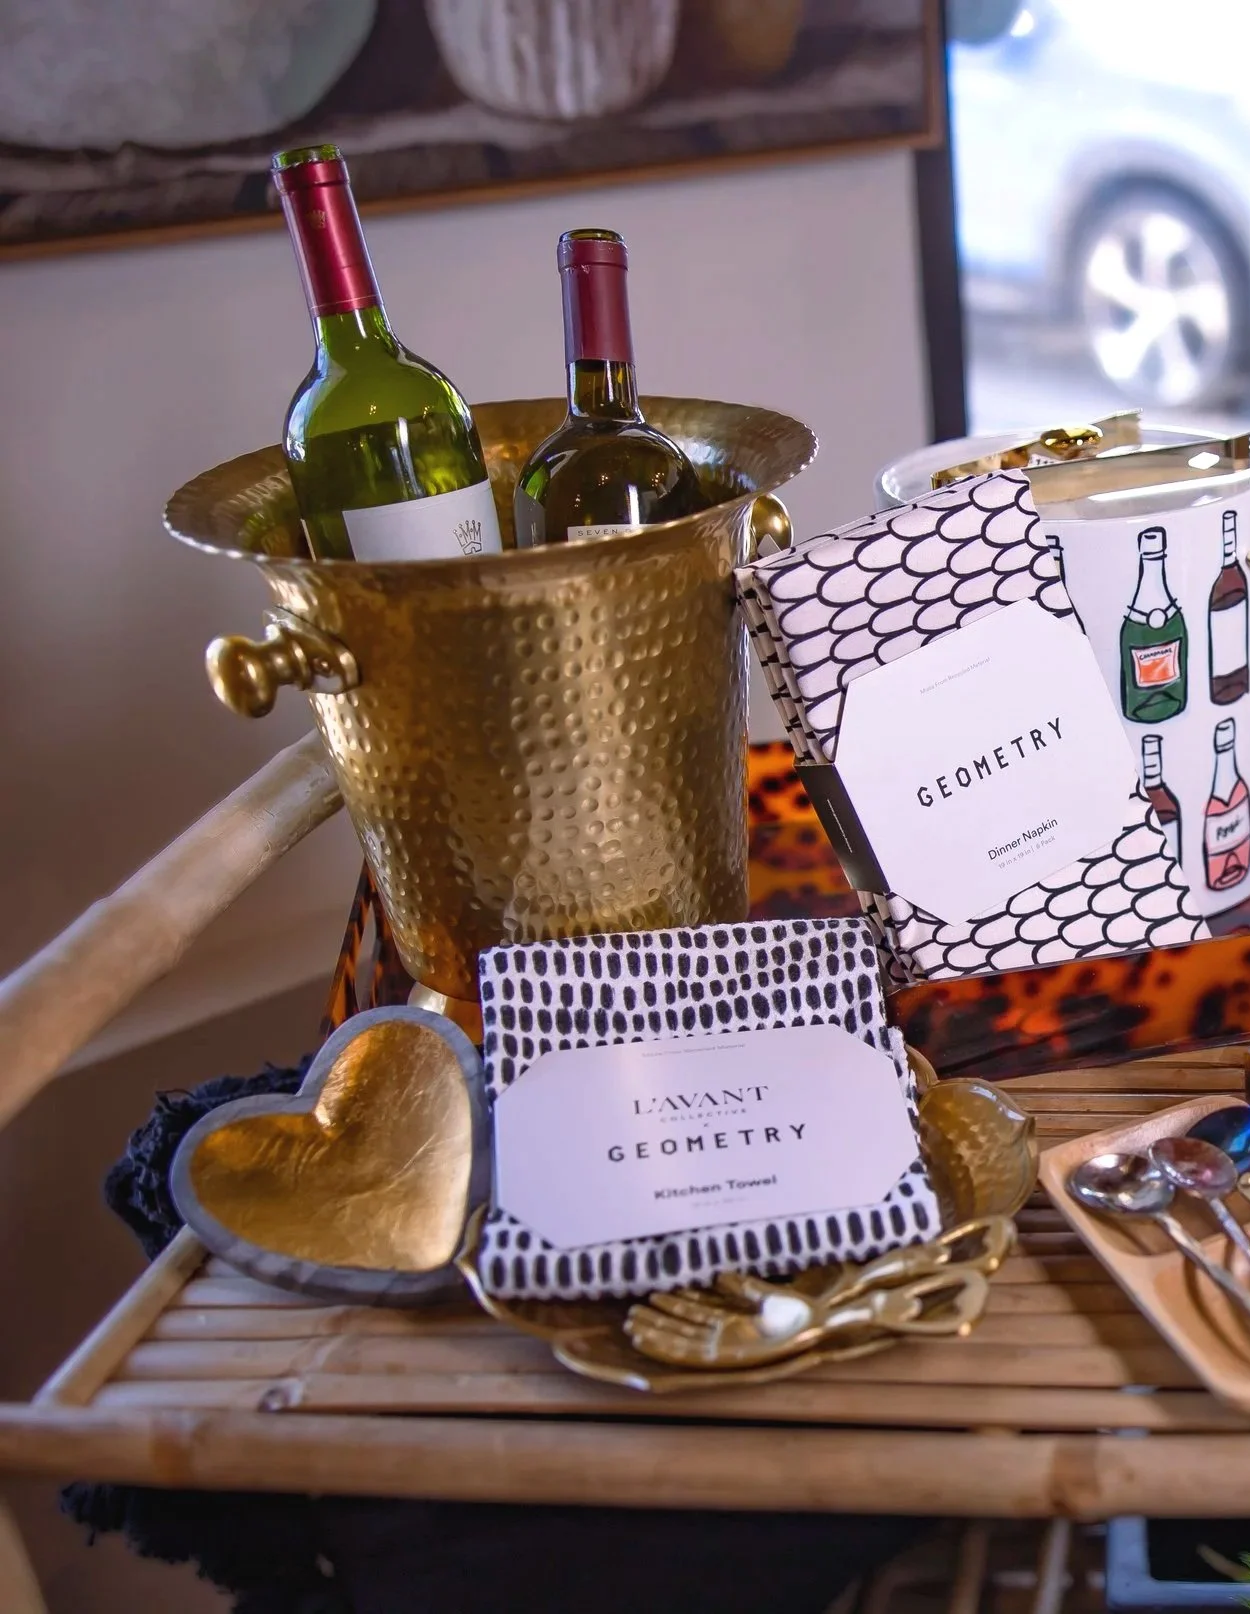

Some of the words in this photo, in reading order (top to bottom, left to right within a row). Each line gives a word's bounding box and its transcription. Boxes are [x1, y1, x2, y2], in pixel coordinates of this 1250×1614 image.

[577, 528, 618, 537] SEVEN
[917, 717, 1062, 807] GEOMETRY
[987, 837, 1021, 860] Dinner
[1022, 819, 1058, 842] Napkin
[633, 1085, 769, 1115] L'AVANT
[659, 1108, 747, 1124] COLLECTIVE
[607, 1123, 806, 1162] GEOMETRY
[654, 1182, 722, 1200] Kitchen
[726, 1174, 777, 1190] Towel
